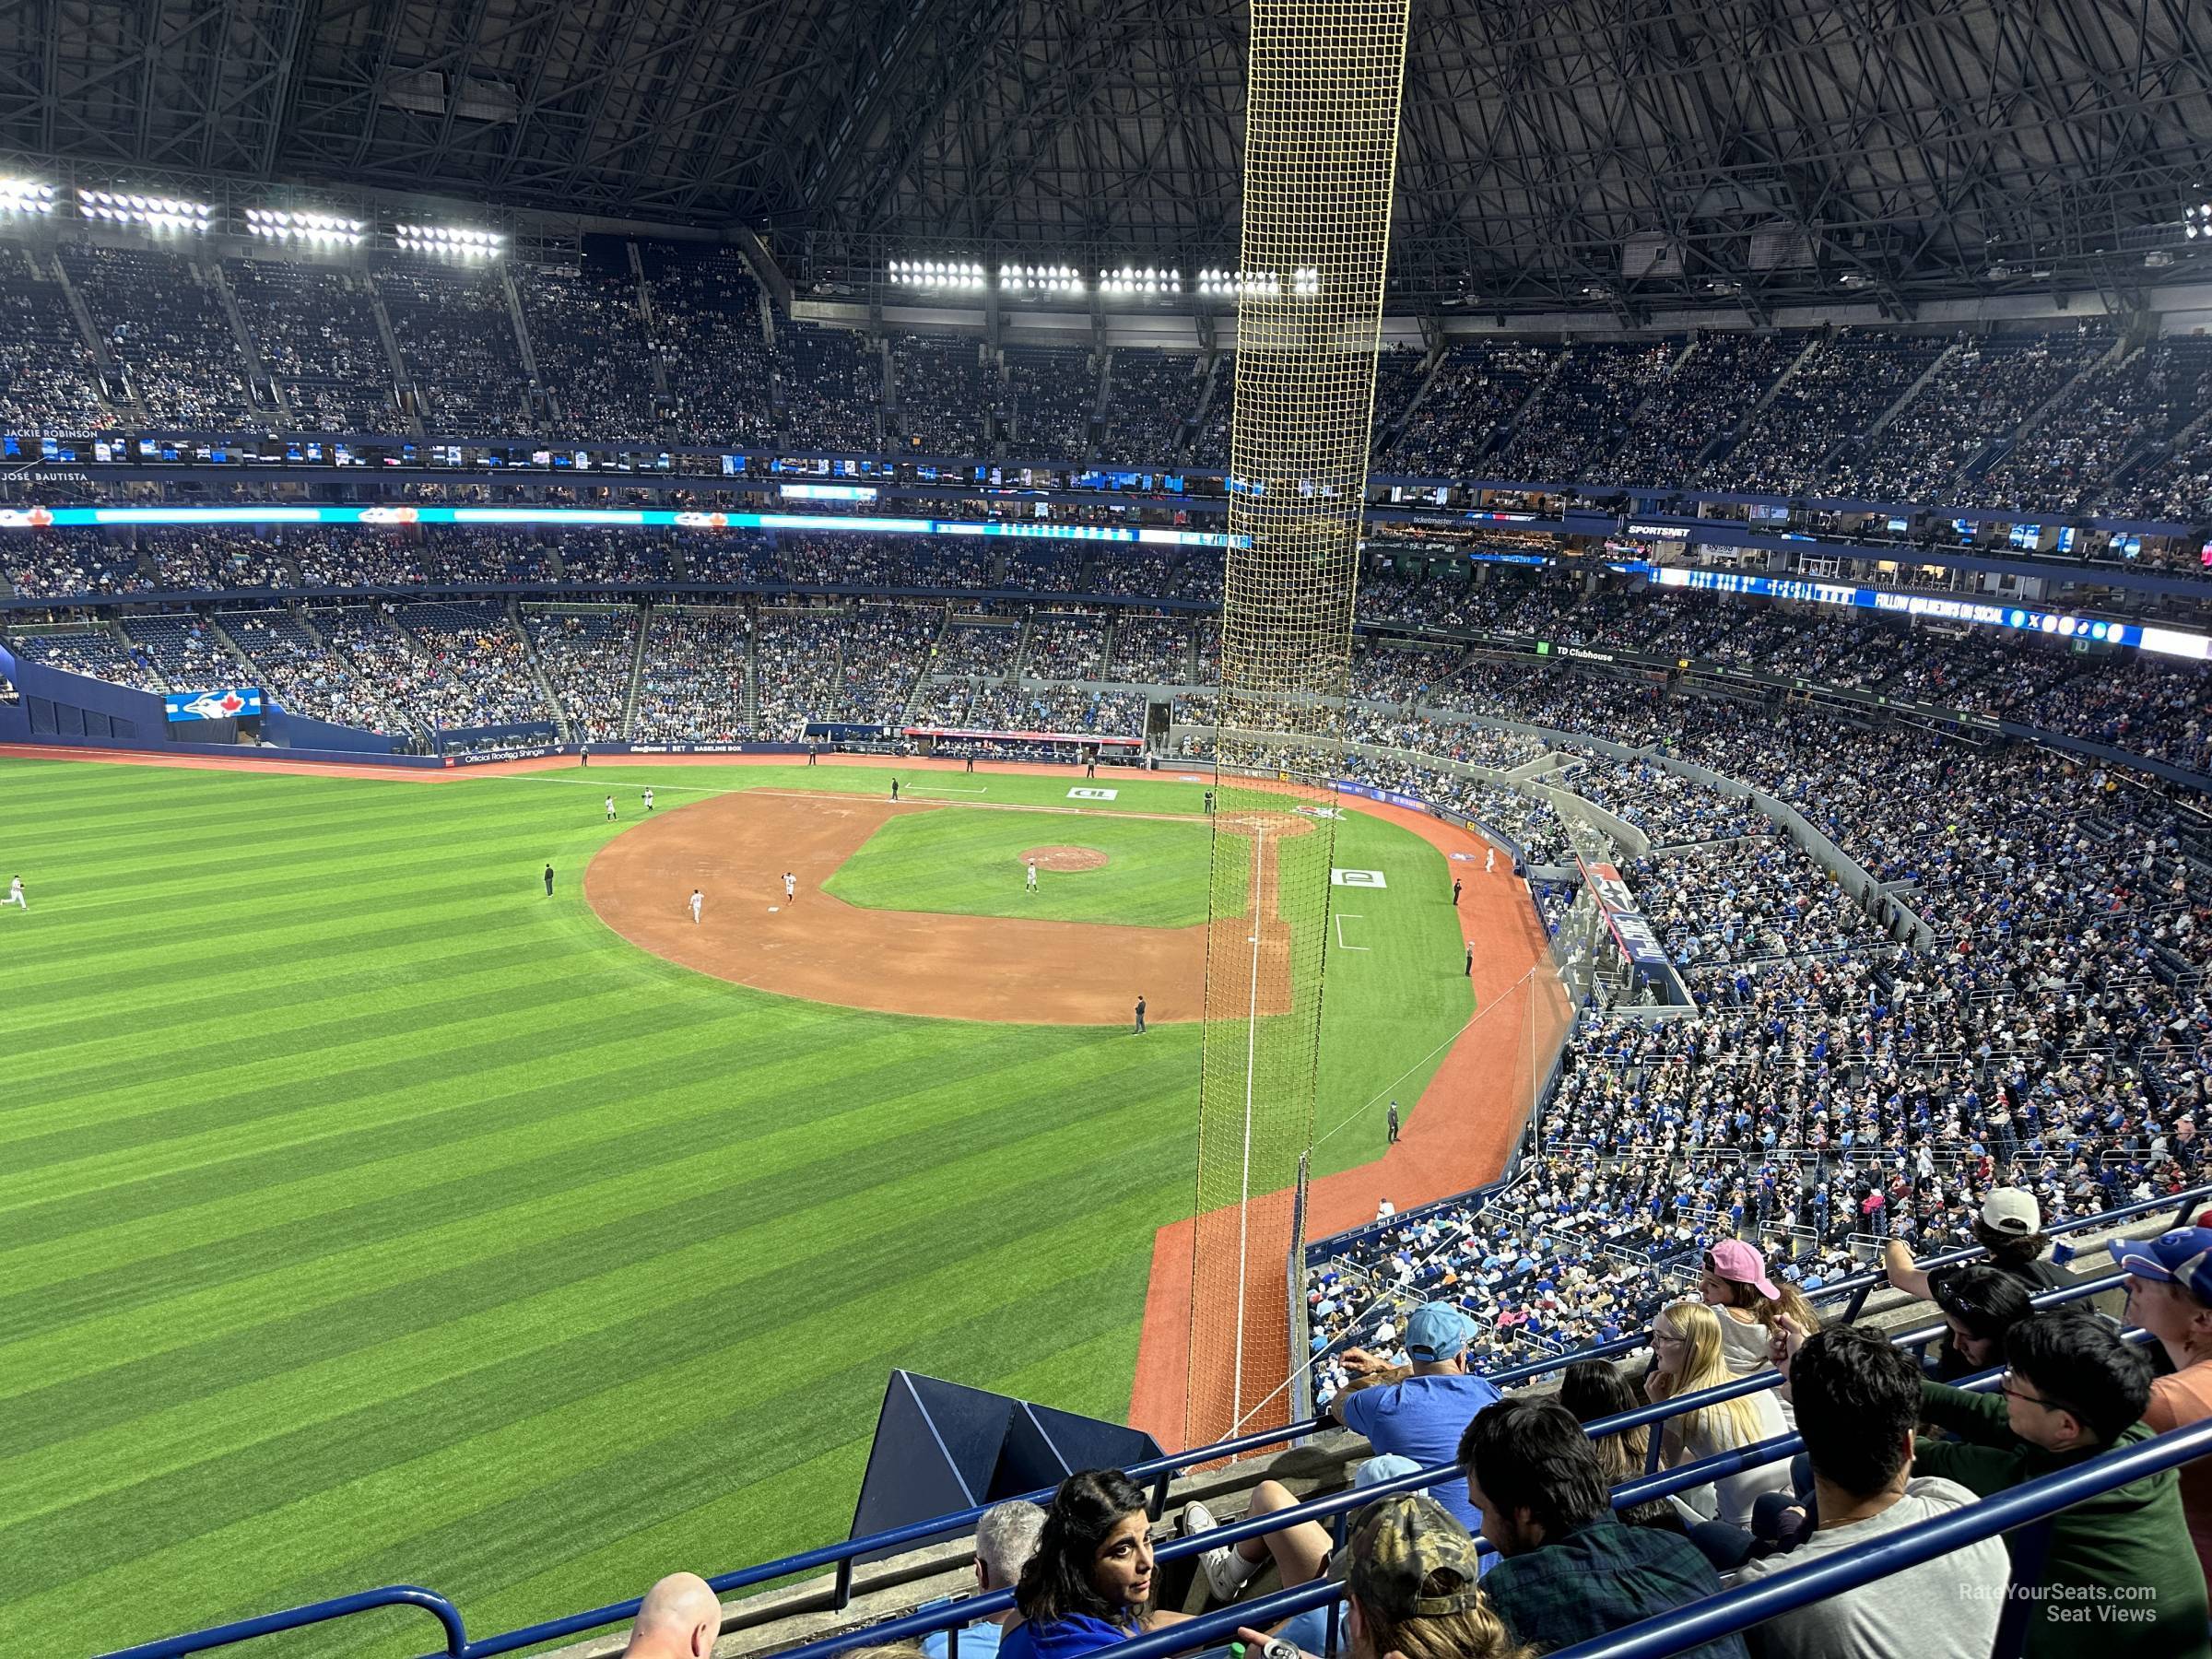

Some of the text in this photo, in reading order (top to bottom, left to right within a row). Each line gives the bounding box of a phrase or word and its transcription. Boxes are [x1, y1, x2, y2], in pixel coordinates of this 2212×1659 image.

[4, 429, 98, 438] JACKIE ROBINSON
[1, 471, 88, 481] JOSÉ BAUTISTA
[1413, 516, 1453, 525] ticketmaster
[1628, 524, 1690, 537] SPORTSNET
[1875, 593, 1909, 610] FOLLOW
[1558, 646, 1568, 654] TD
[1569, 648, 1613, 662] Clubhouse
[465, 747, 545, 763] Official Roofing Shingle
